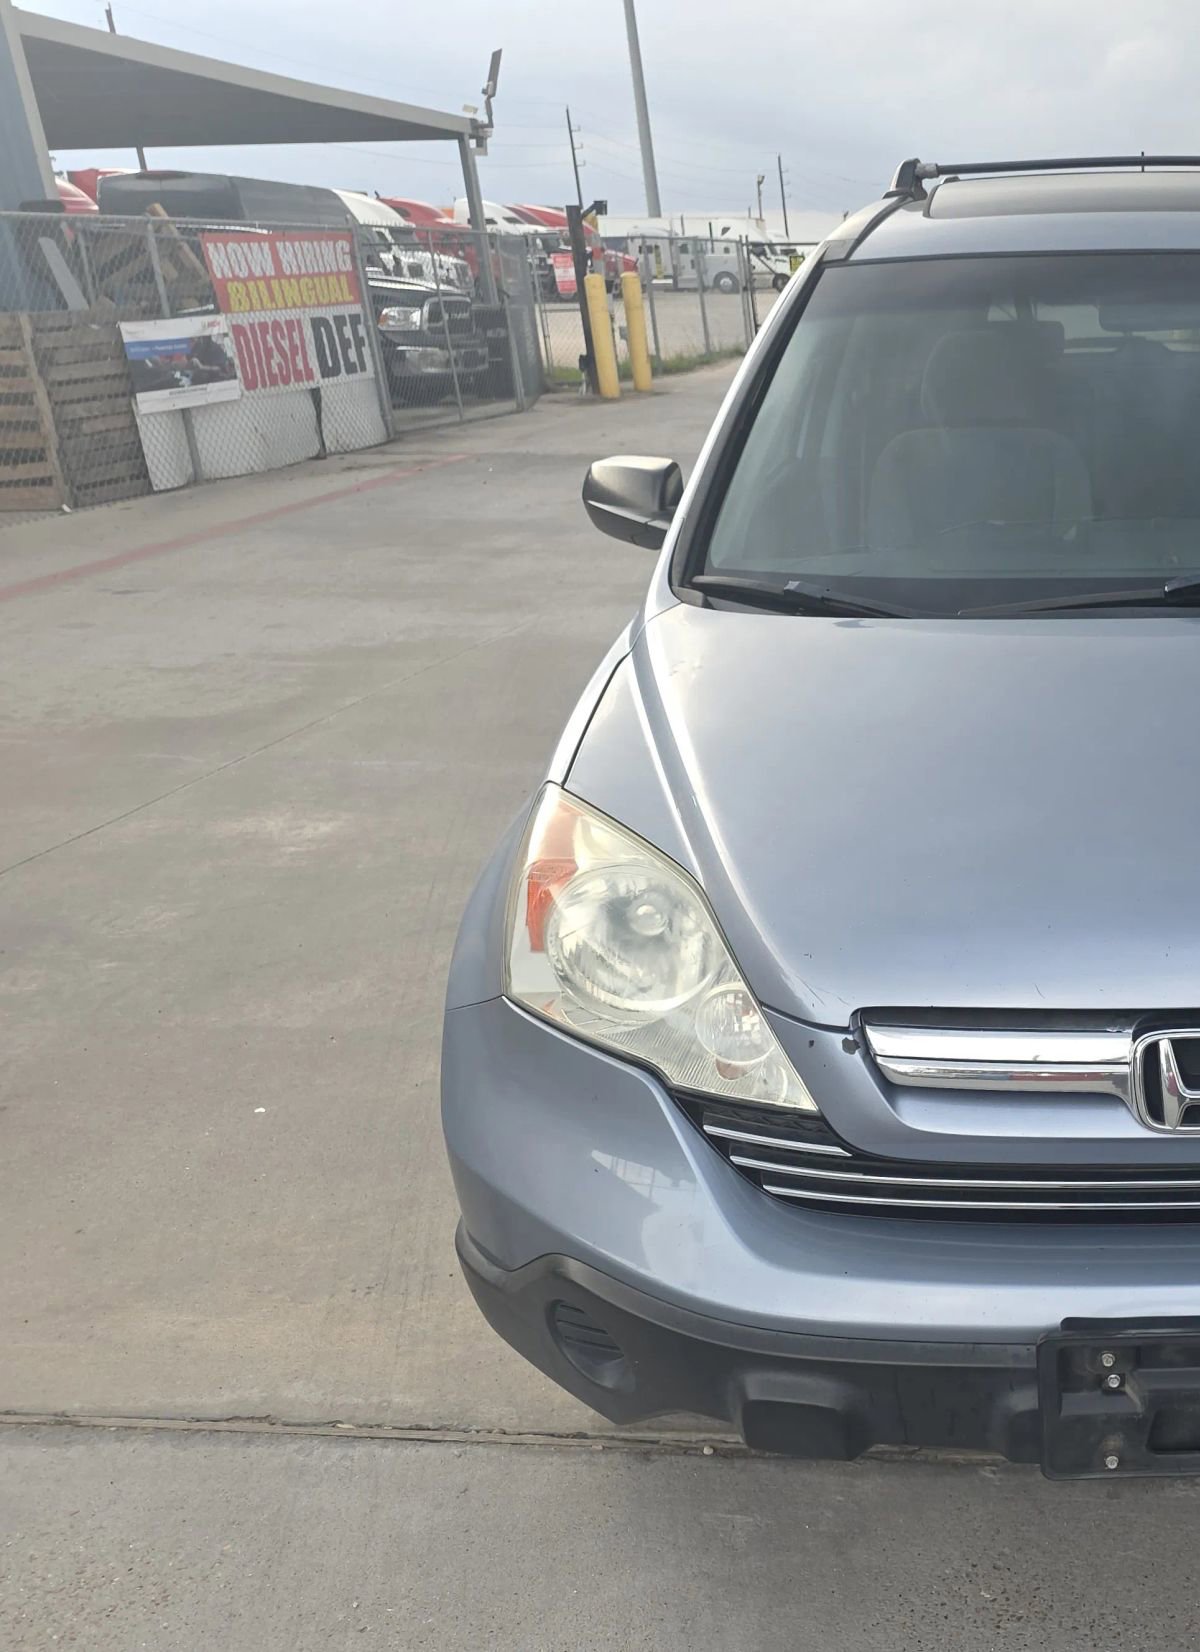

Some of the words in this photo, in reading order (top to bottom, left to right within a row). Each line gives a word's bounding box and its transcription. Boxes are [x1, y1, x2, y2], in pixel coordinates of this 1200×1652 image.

[206, 241, 275, 279] NOW
[275, 240, 353, 276] HIRING
[226, 273, 354, 313] BILINGUAL
[231, 319, 314, 391] DIESEL
[309, 313, 367, 379] DEF
